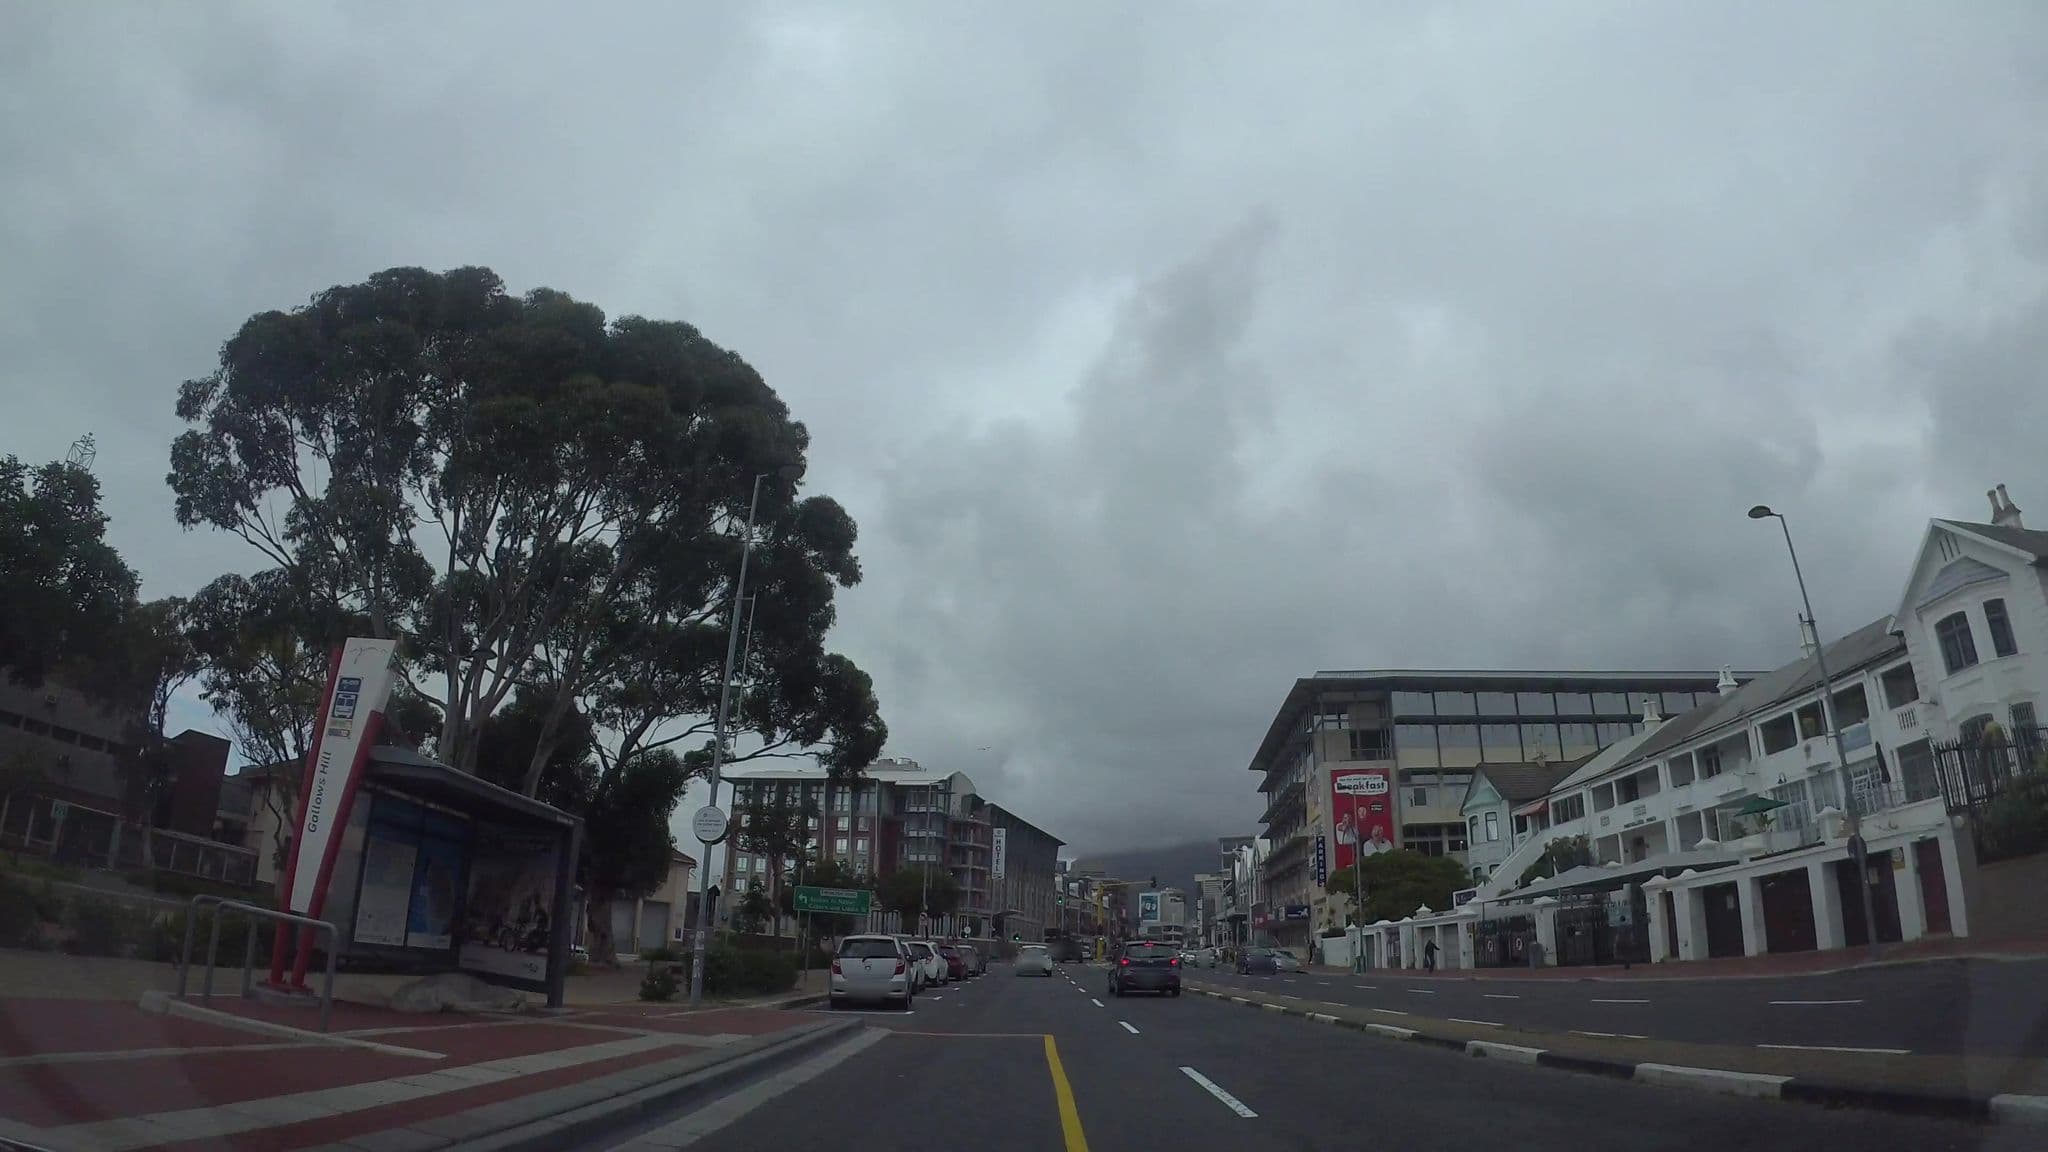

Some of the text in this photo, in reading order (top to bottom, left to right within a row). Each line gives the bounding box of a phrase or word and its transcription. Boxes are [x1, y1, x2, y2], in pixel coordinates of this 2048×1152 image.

[308, 751, 332, 833] Gallows Hill
[1336, 781, 1385, 790] Breakfast
